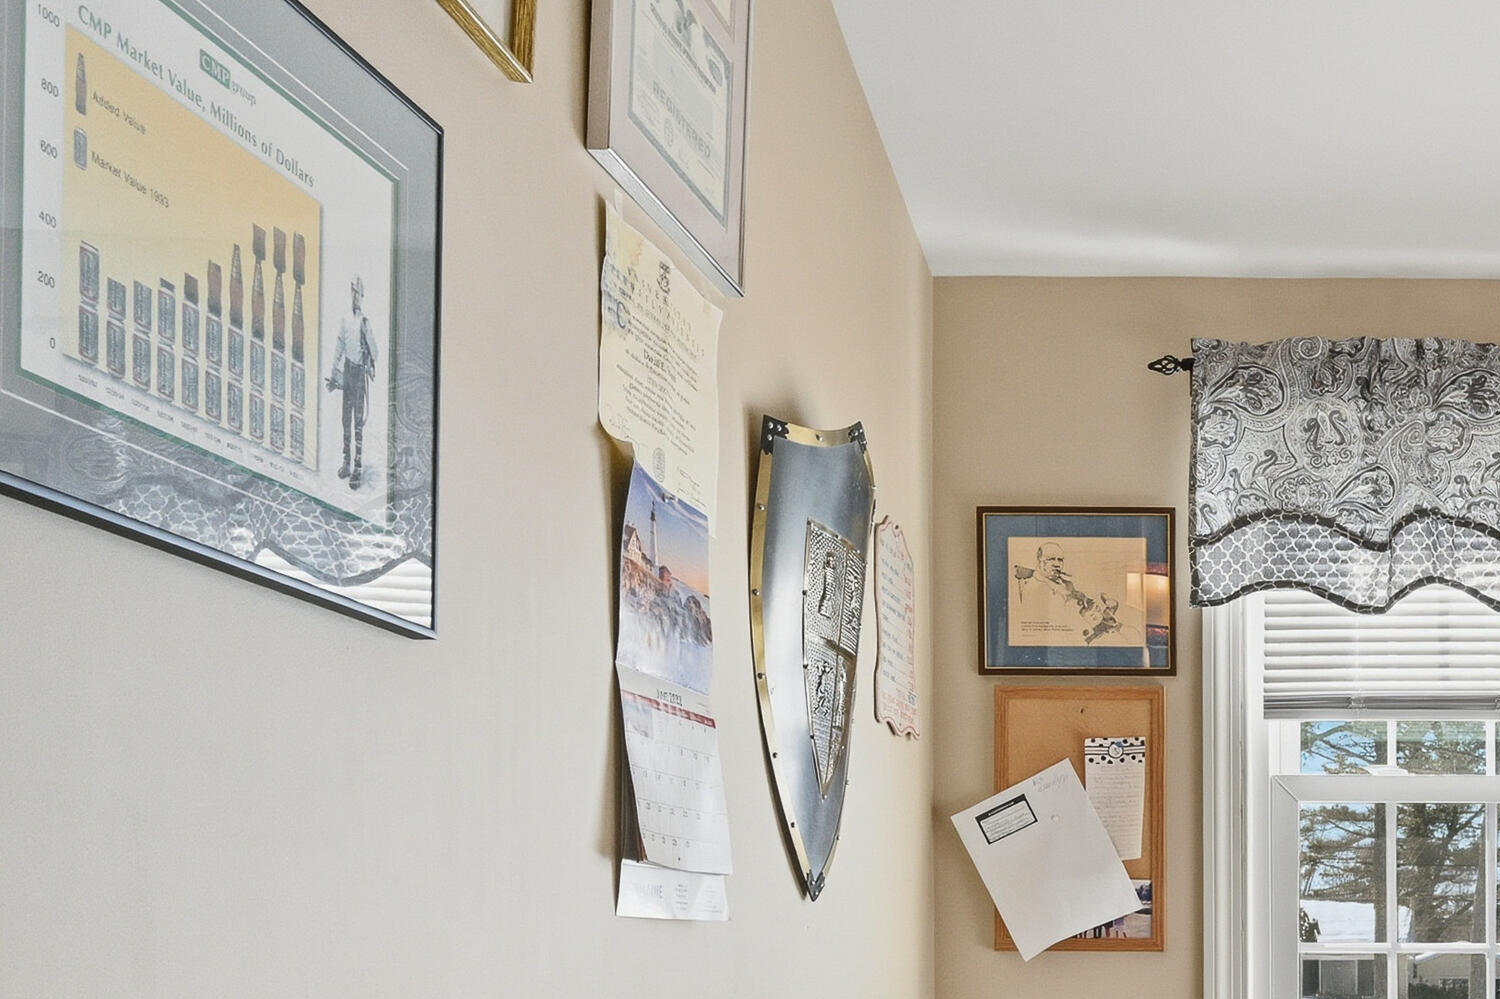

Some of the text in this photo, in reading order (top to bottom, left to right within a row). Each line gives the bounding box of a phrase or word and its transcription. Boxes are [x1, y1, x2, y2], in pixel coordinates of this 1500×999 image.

[38, 4, 60, 27] 1000
[201, 53, 229, 89] CMP
[41, 78, 59, 97] 800
[78, 5, 315, 188] CMP Market Value, Millions of Dollars
[91, 151, 121, 180] Market
[124, 172, 147, 196] Value
[38, 211, 57, 229] 400
[37, 271, 56, 290] 200
